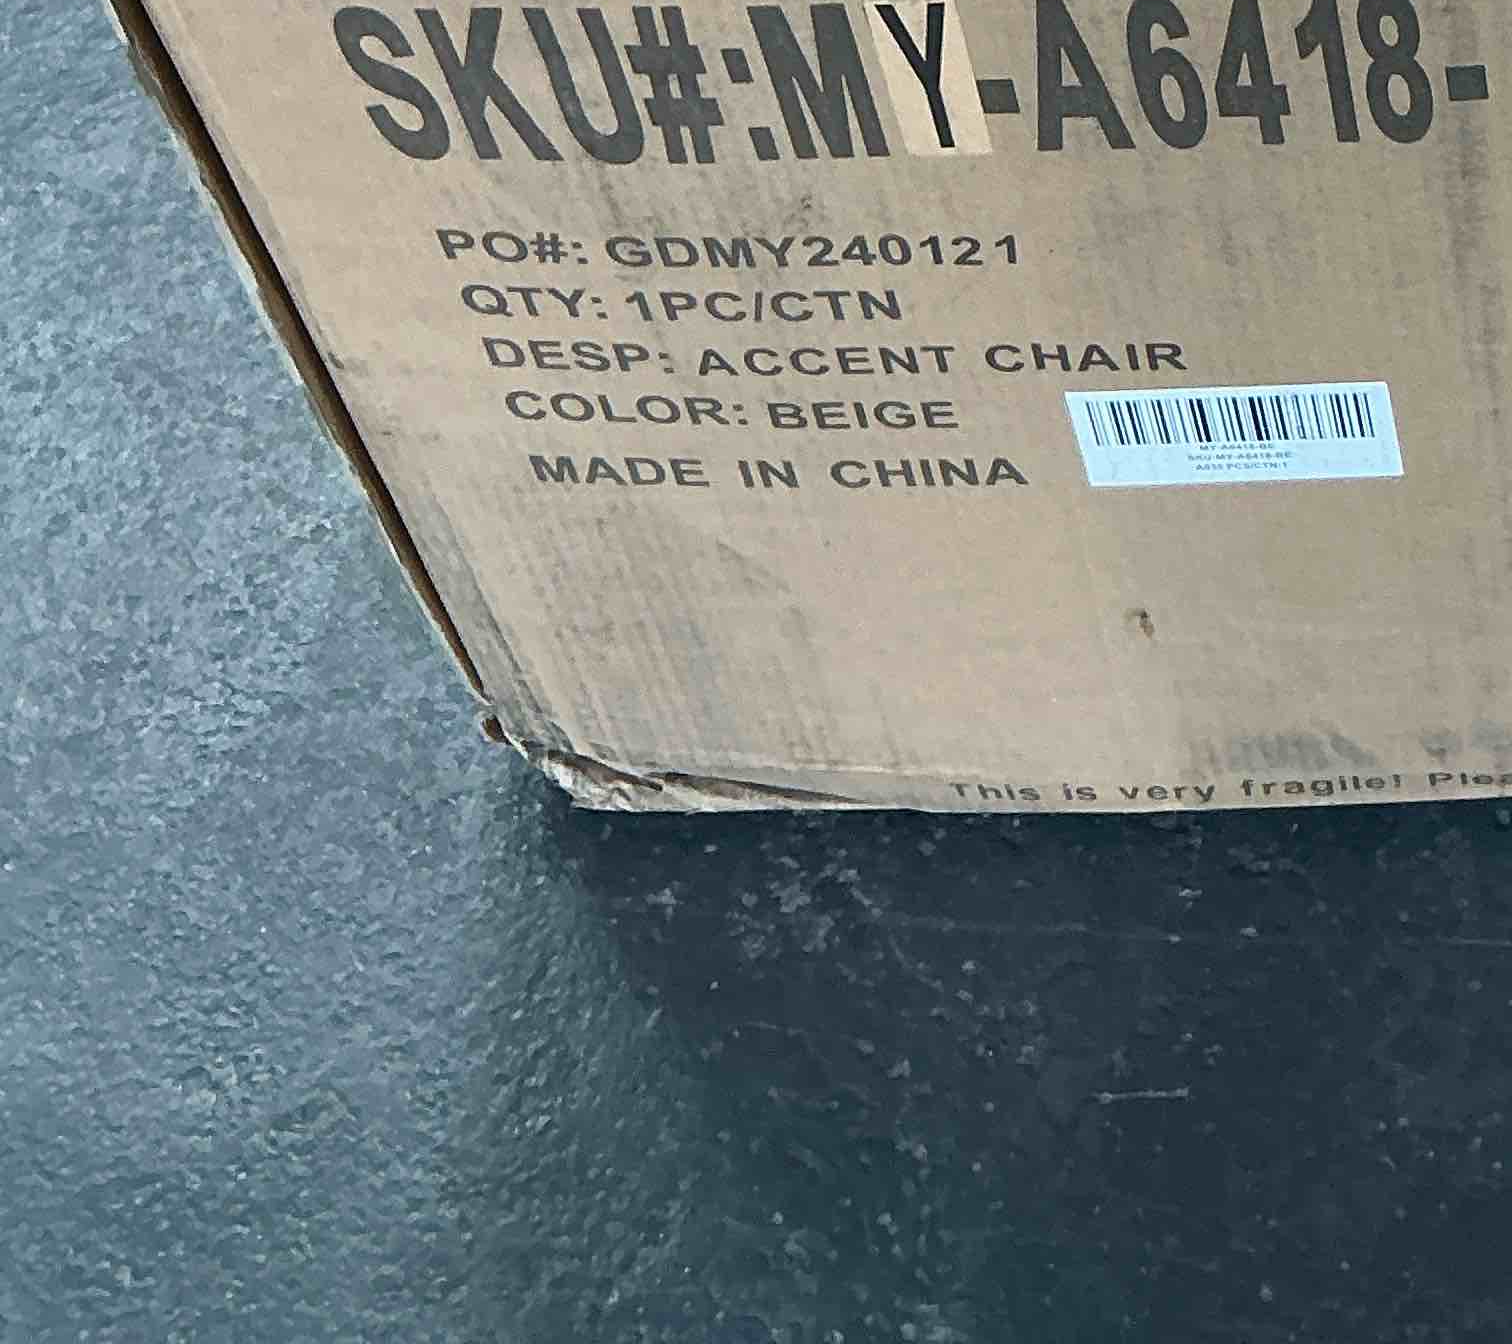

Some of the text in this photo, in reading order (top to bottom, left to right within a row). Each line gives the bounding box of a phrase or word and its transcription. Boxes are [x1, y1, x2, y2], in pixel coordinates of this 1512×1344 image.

[437, 227, 1020, 269] PO#: GDMY240121
[461, 284, 903, 324] QTY: 1PC/CTN
[481, 336, 1189, 377] DESP: ACCENT CHAIR
[505, 390, 961, 432] COLOR: BEIGE
[529, 454, 1029, 490] MADE IN CHINA
[950, 781, 1041, 802] This
[1061, 781, 1098, 801] is
[1118, 783, 1216, 803] very
[1239, 771, 1405, 798] fragile!
